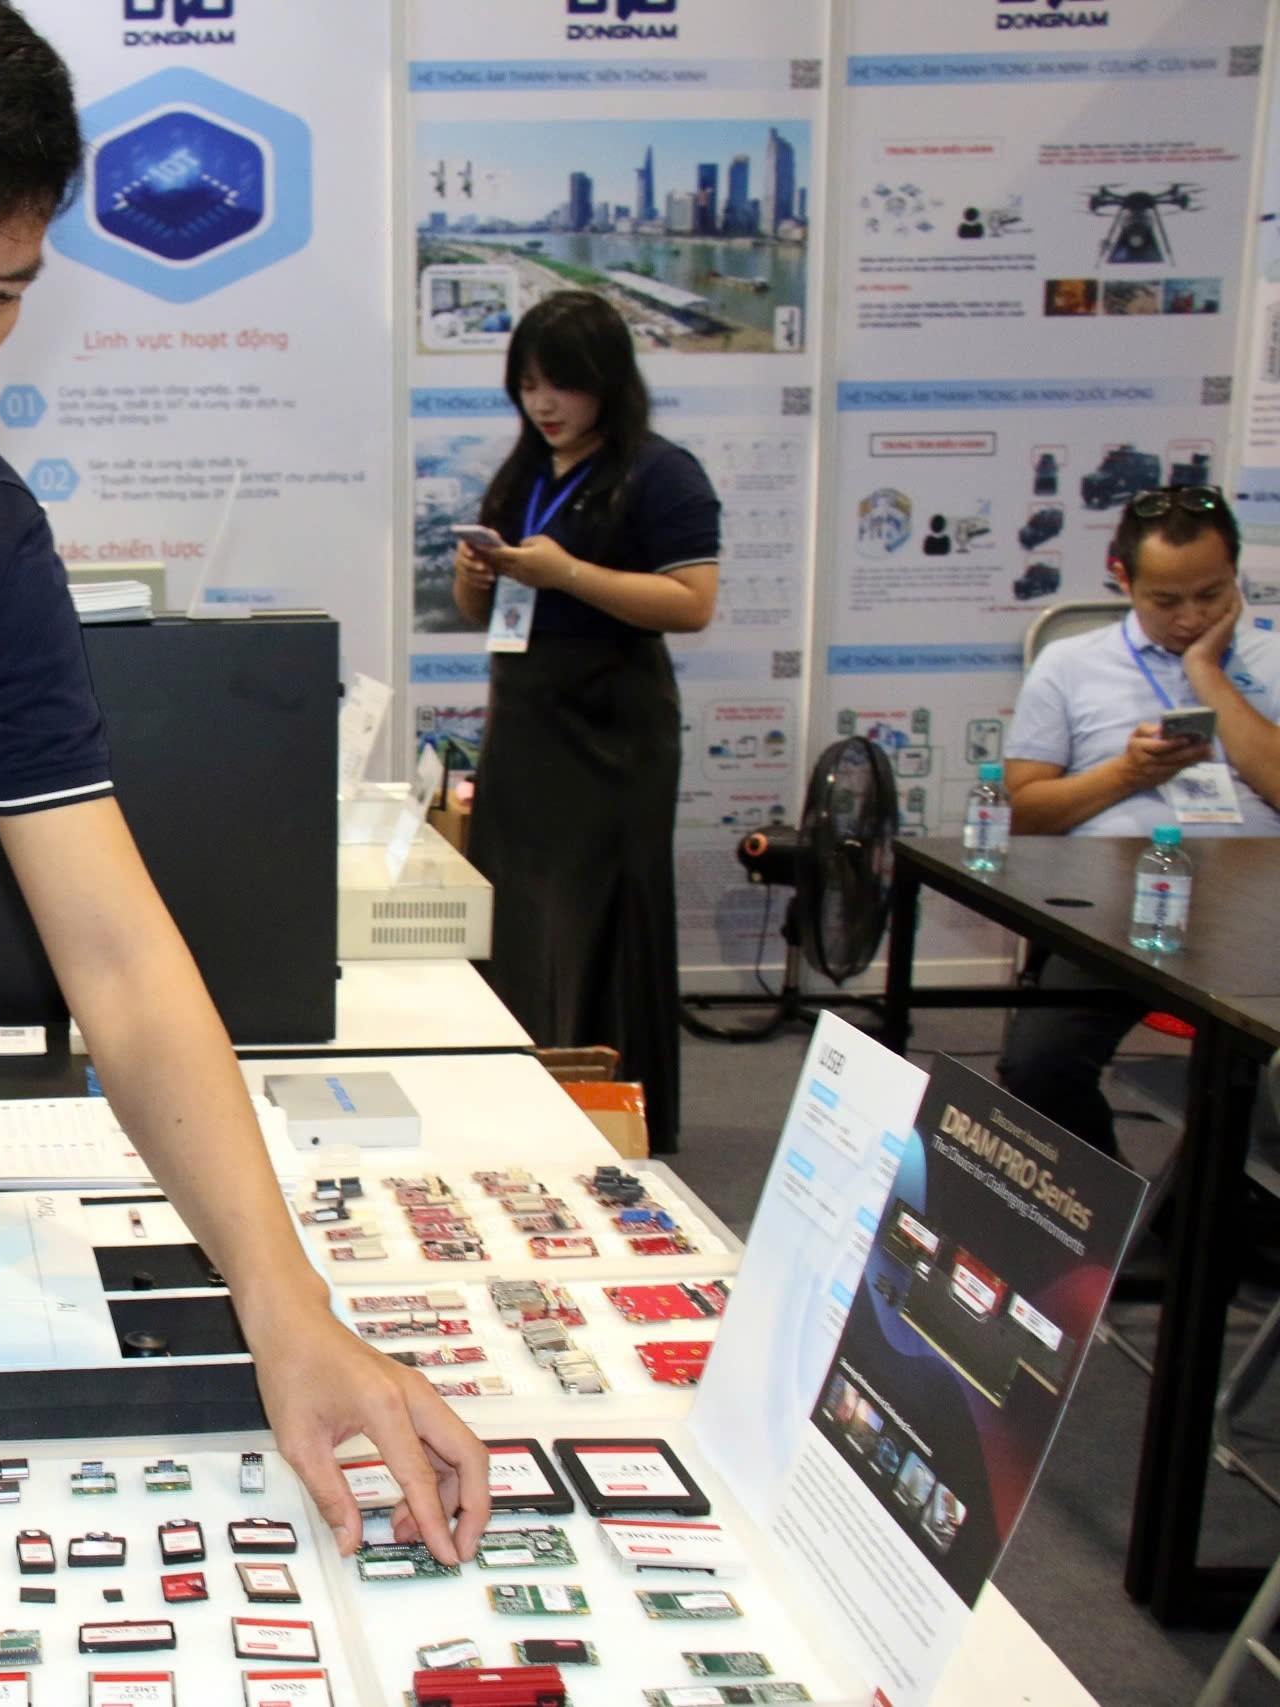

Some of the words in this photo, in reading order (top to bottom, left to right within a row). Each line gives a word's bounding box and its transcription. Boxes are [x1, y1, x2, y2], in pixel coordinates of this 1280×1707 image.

[566, 24, 678, 40] DONGNAM
[995, 12, 1109, 30] DONGNAM
[123, 31, 235, 46] DONGNAM
[236, 329, 289, 355] động
[5, 393, 37, 418] 01
[39, 467, 69, 491] 02
[938, 1103, 1001, 1164] DRAM
[995, 1141, 1038, 1191] PRO
[1033, 1168, 1094, 1232] Series
[932, 1133, 951, 1155] The
[1027, 1204, 1087, 1257] Environments
